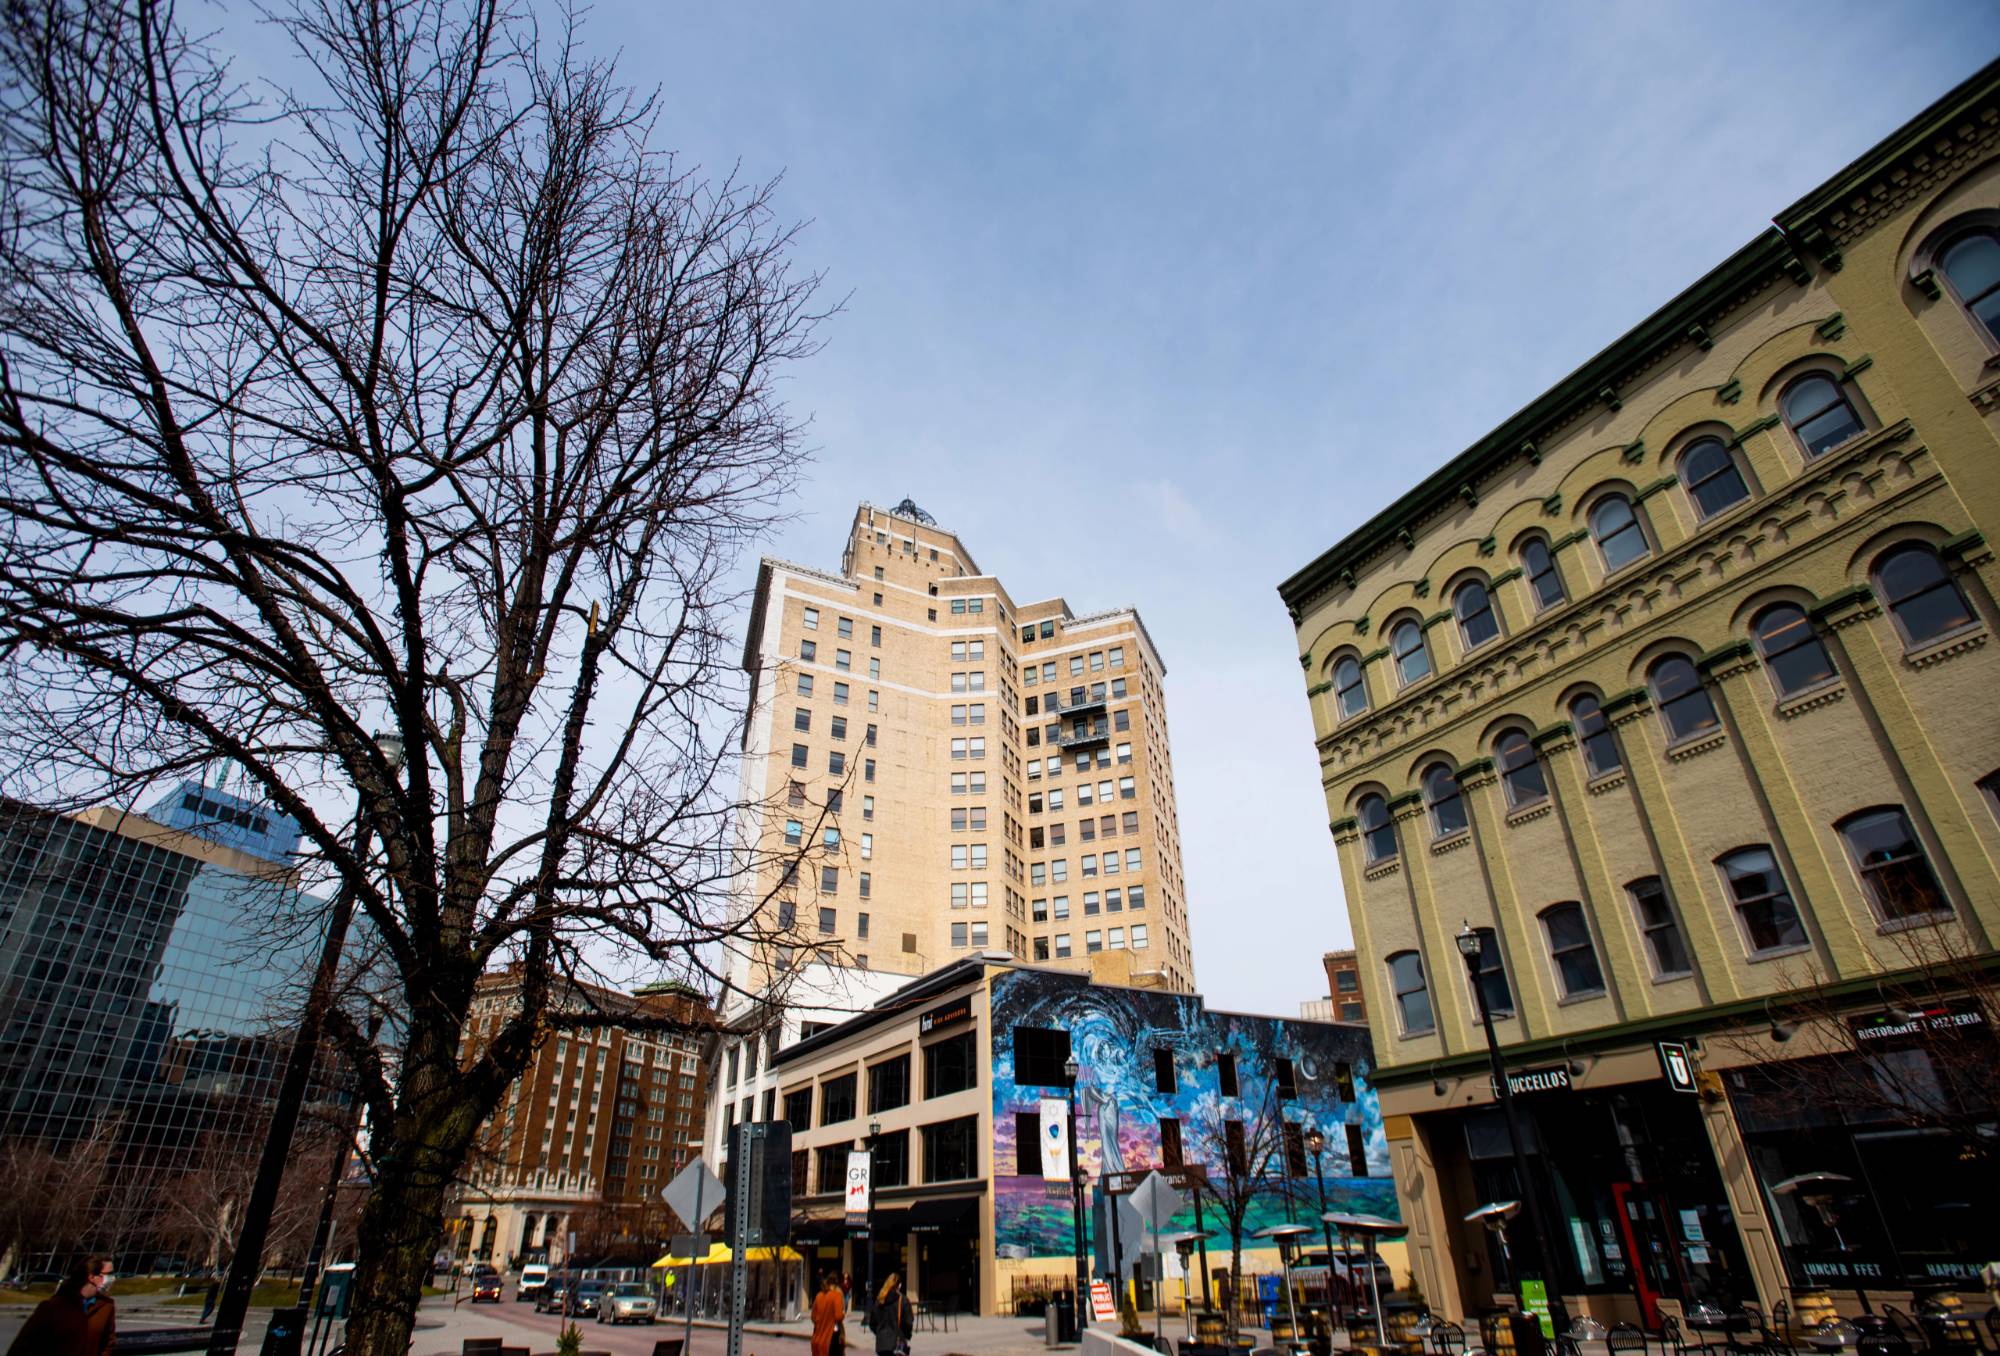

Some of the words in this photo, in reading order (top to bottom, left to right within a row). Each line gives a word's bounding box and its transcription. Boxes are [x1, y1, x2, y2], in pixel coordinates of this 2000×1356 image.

[1857, 1022, 1920, 1040] RISTORANTE
[849, 1167, 868, 1181] GR
[1803, 1263, 1838, 1277] LUNCH
[1840, 1263, 1882, 1277] BFFET
[1926, 1263, 1966, 1277] HAPPY
